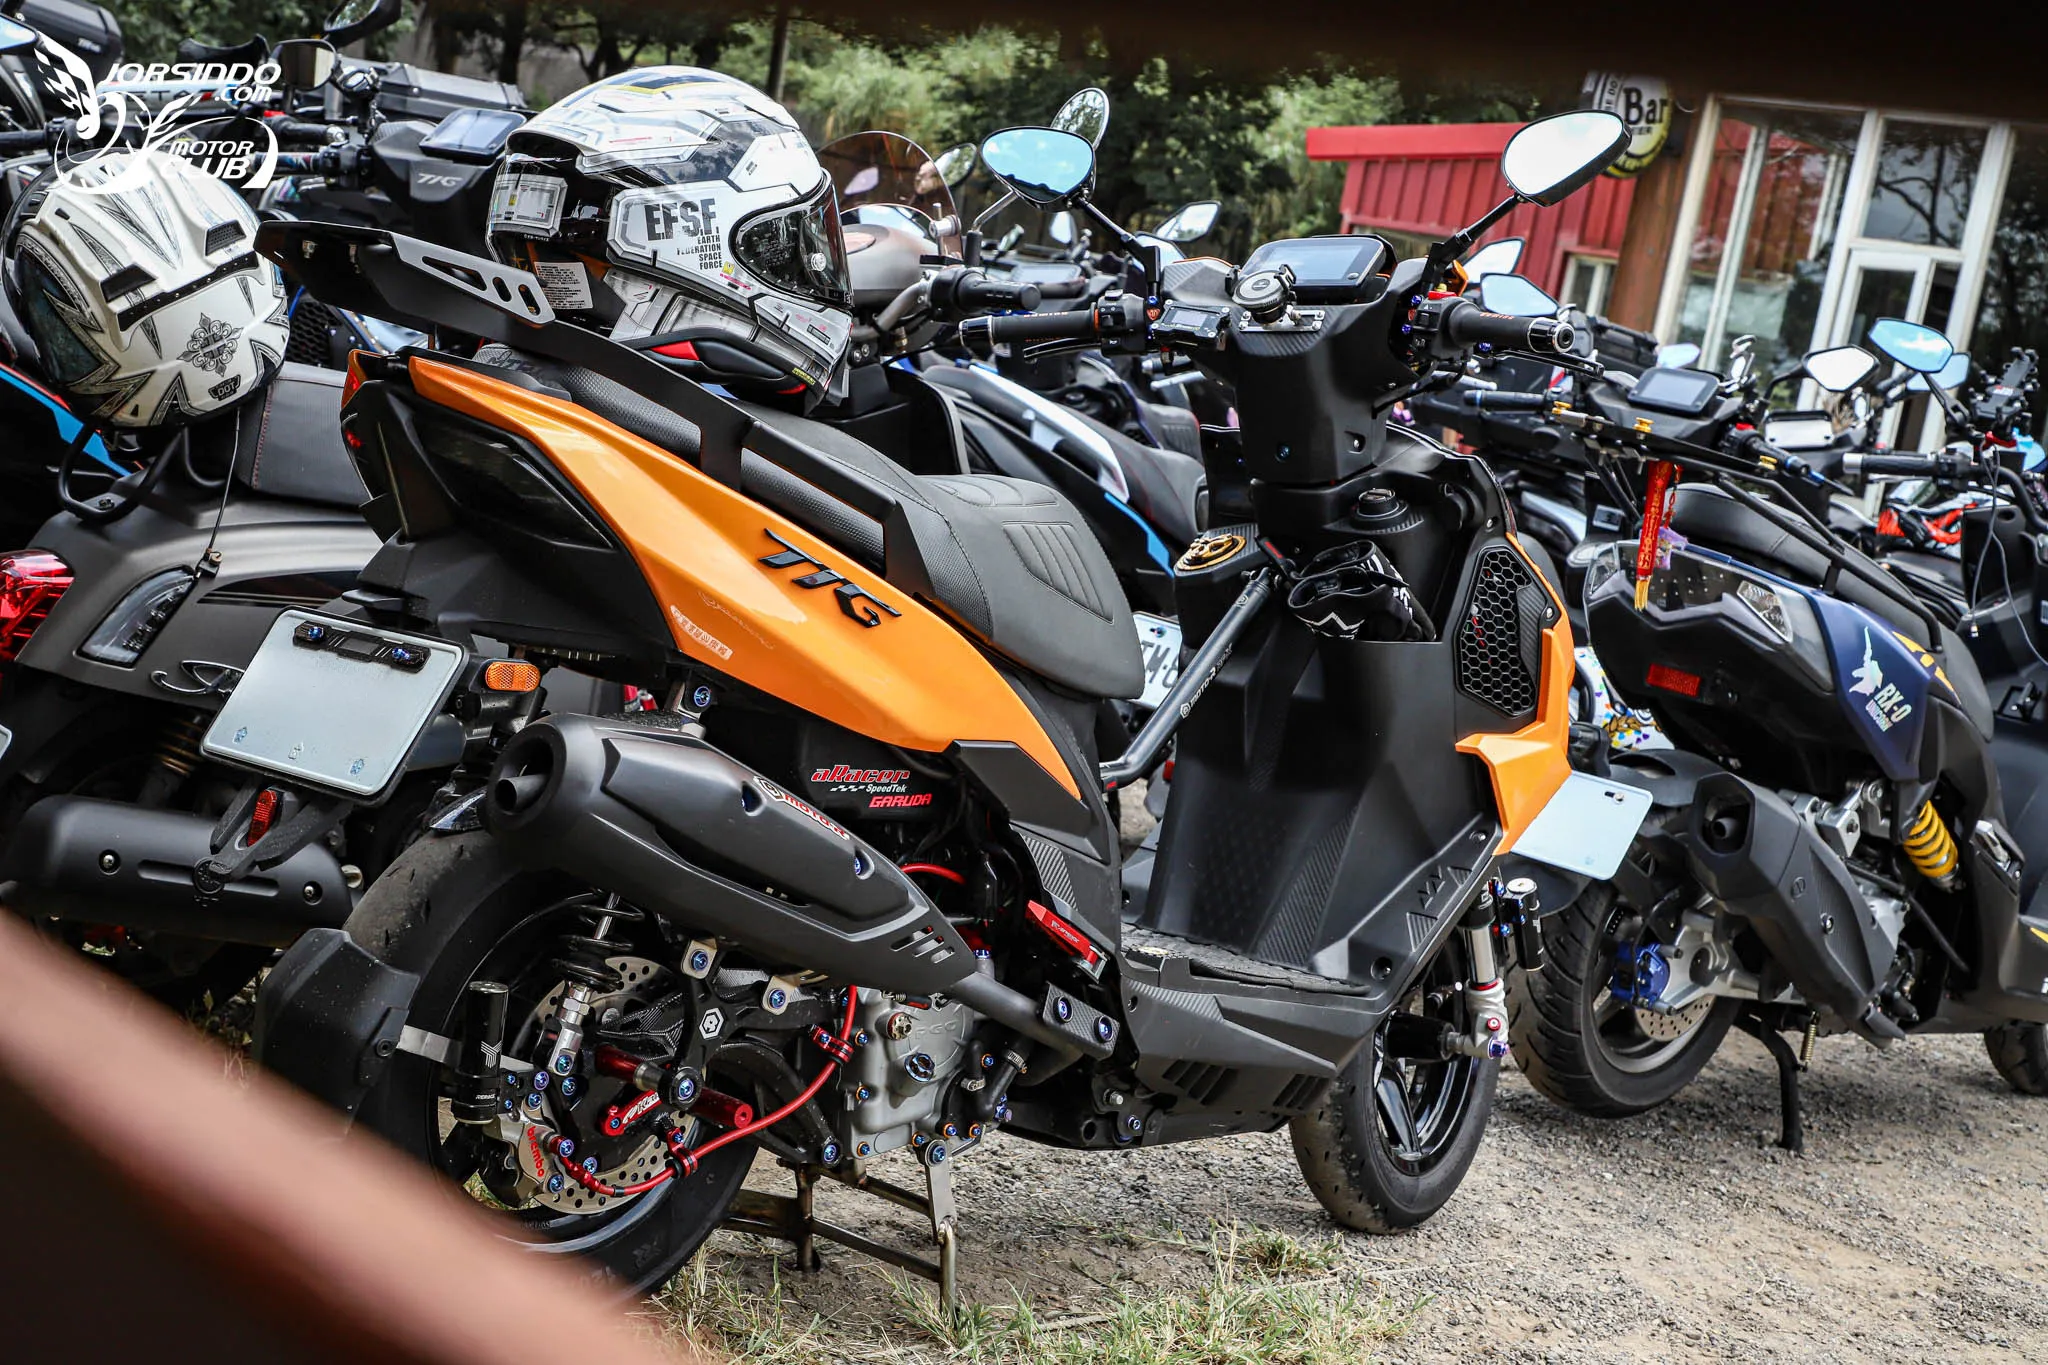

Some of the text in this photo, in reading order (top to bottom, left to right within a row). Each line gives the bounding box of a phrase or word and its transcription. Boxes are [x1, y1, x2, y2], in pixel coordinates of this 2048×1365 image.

[1623, 87, 1669, 125] Bar
[697, 235, 721, 245] EARTH
[698, 252, 722, 262] SPACE
[699, 262, 723, 270] FORCE
[217, 381, 236, 396] DOT
[1865, 699, 1894, 732] UNICORN
[811, 764, 910, 783] aRacer
[866, 784, 908, 794] SpeedTek
[869, 794, 933, 808] GARUDA
[526, 1126, 546, 1178] brembo
